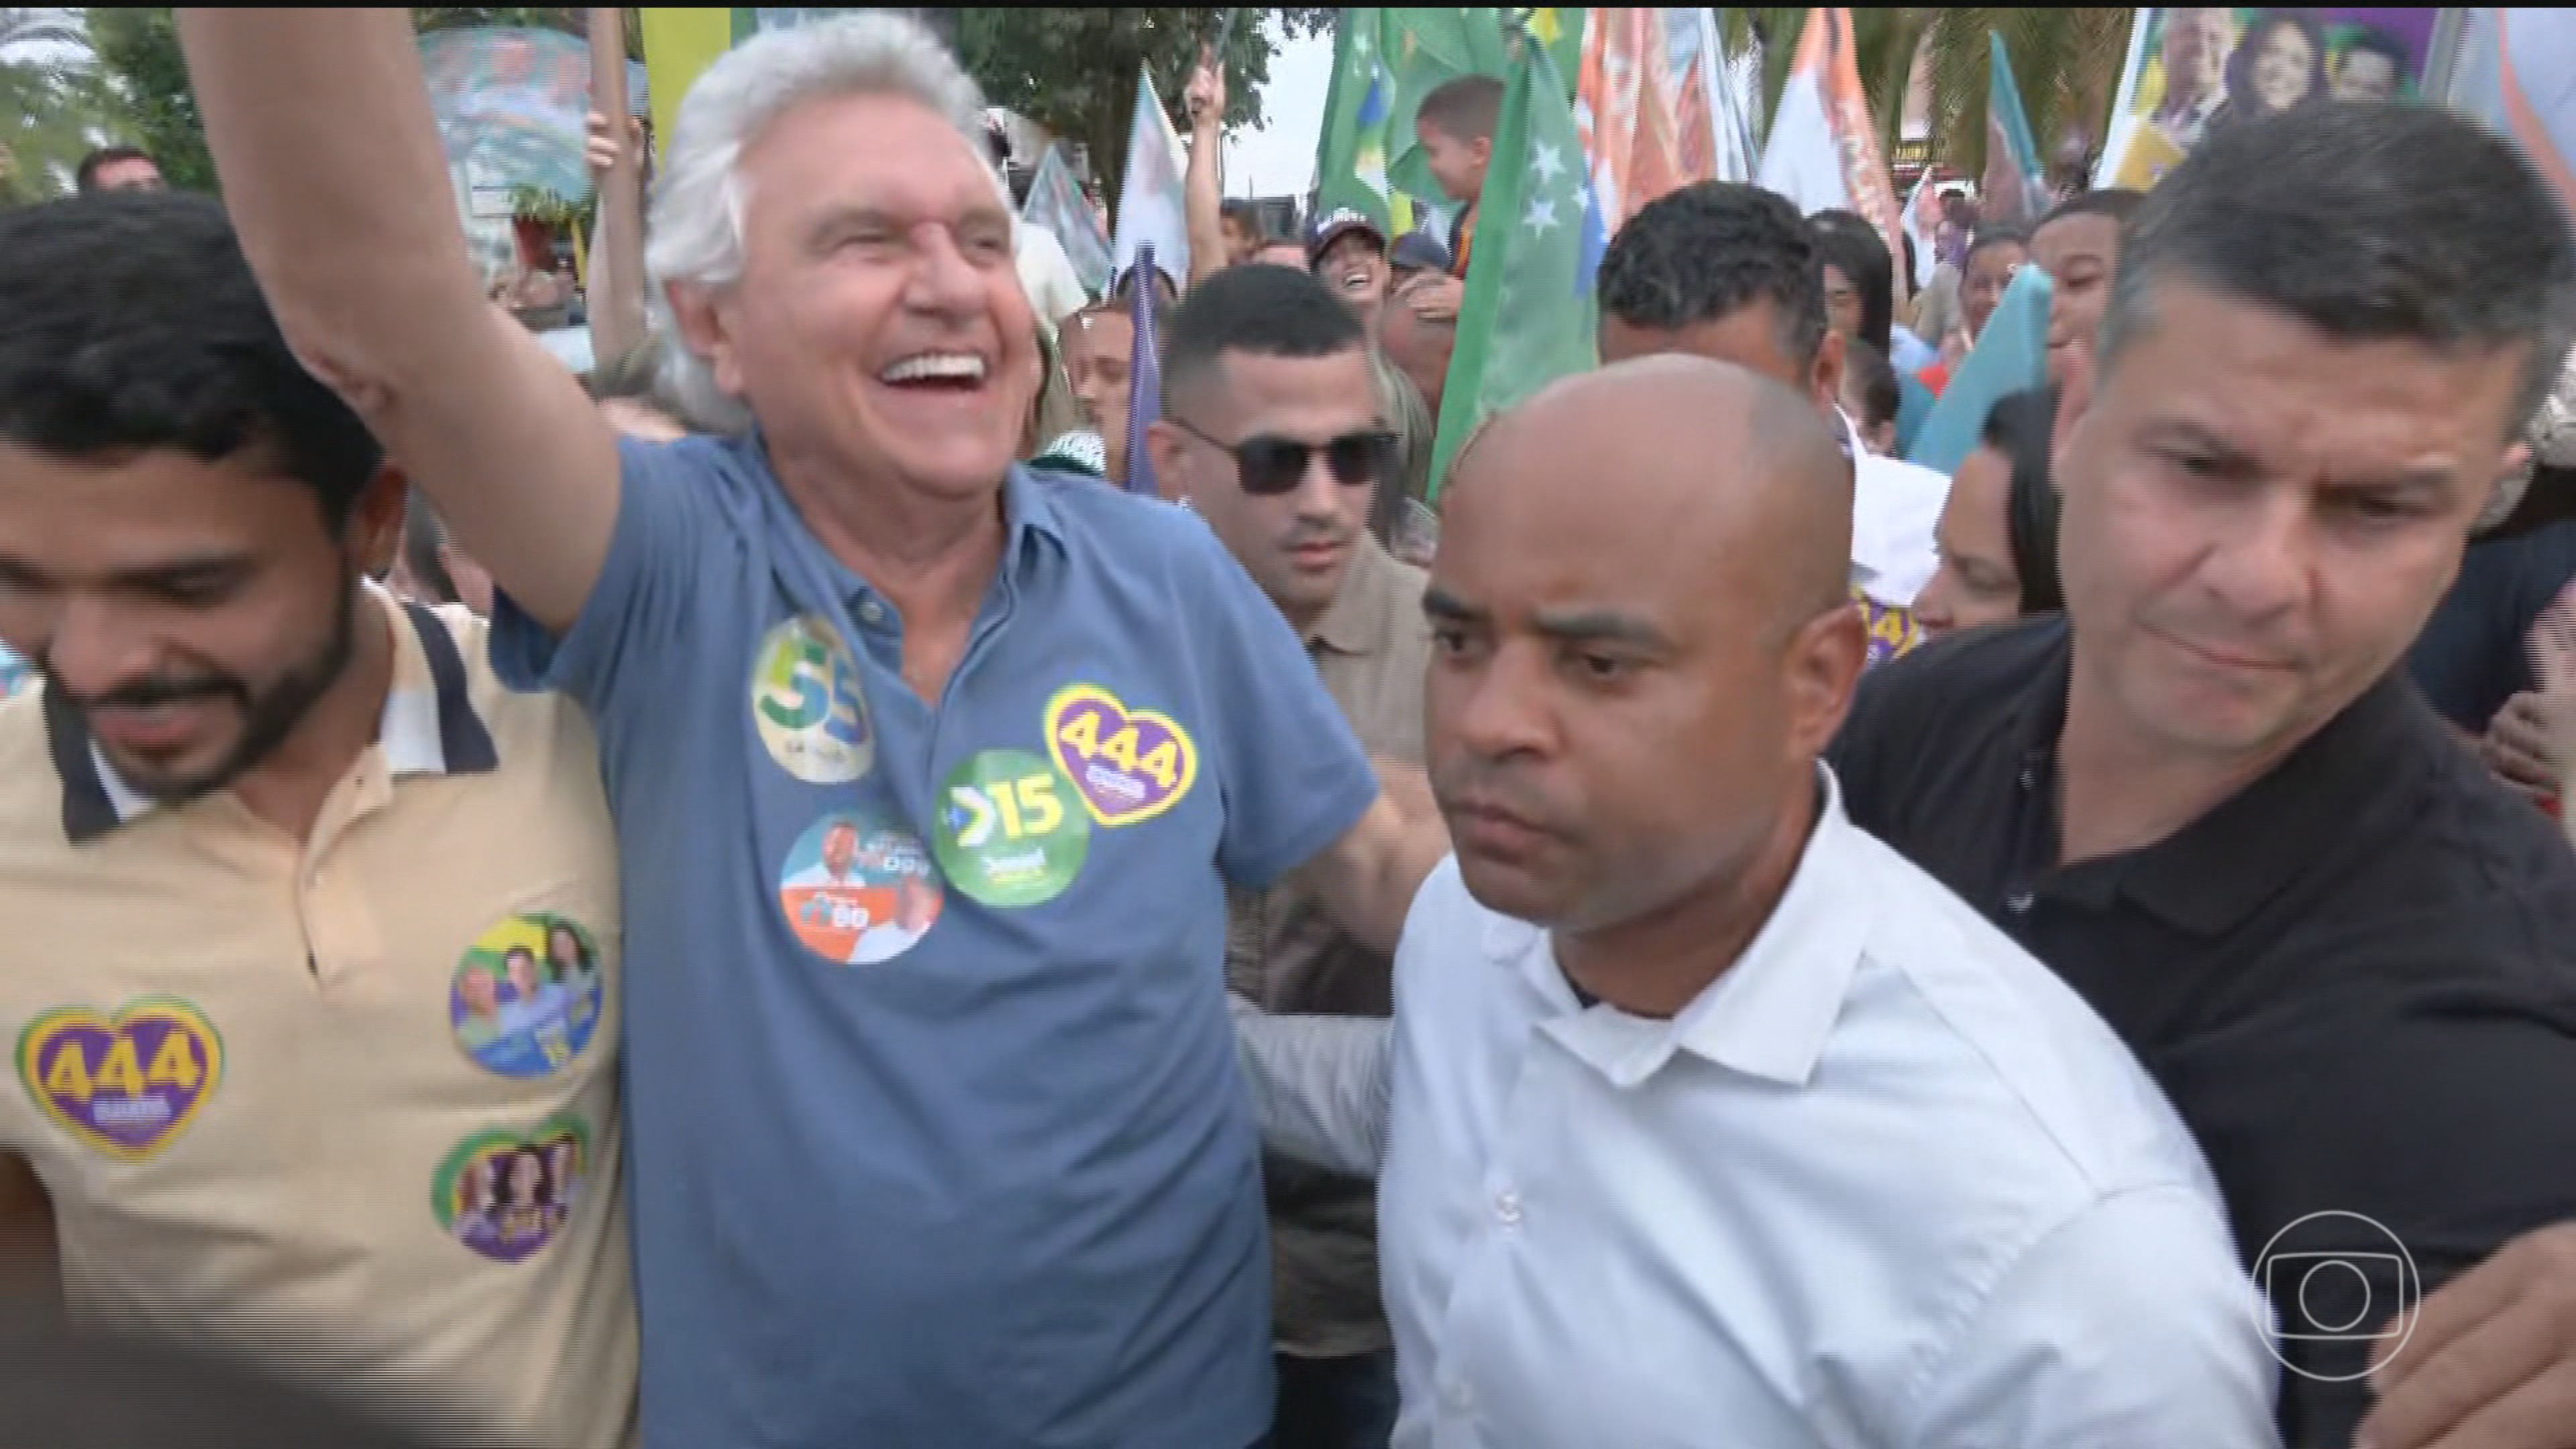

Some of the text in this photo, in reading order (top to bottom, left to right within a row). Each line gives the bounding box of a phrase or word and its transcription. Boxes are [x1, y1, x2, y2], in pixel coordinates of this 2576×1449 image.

[760, 635, 870, 745] 55
[1059, 710, 1179, 787] 444
[984, 773, 1065, 839] 15
[48, 1032, 197, 1099] 444
